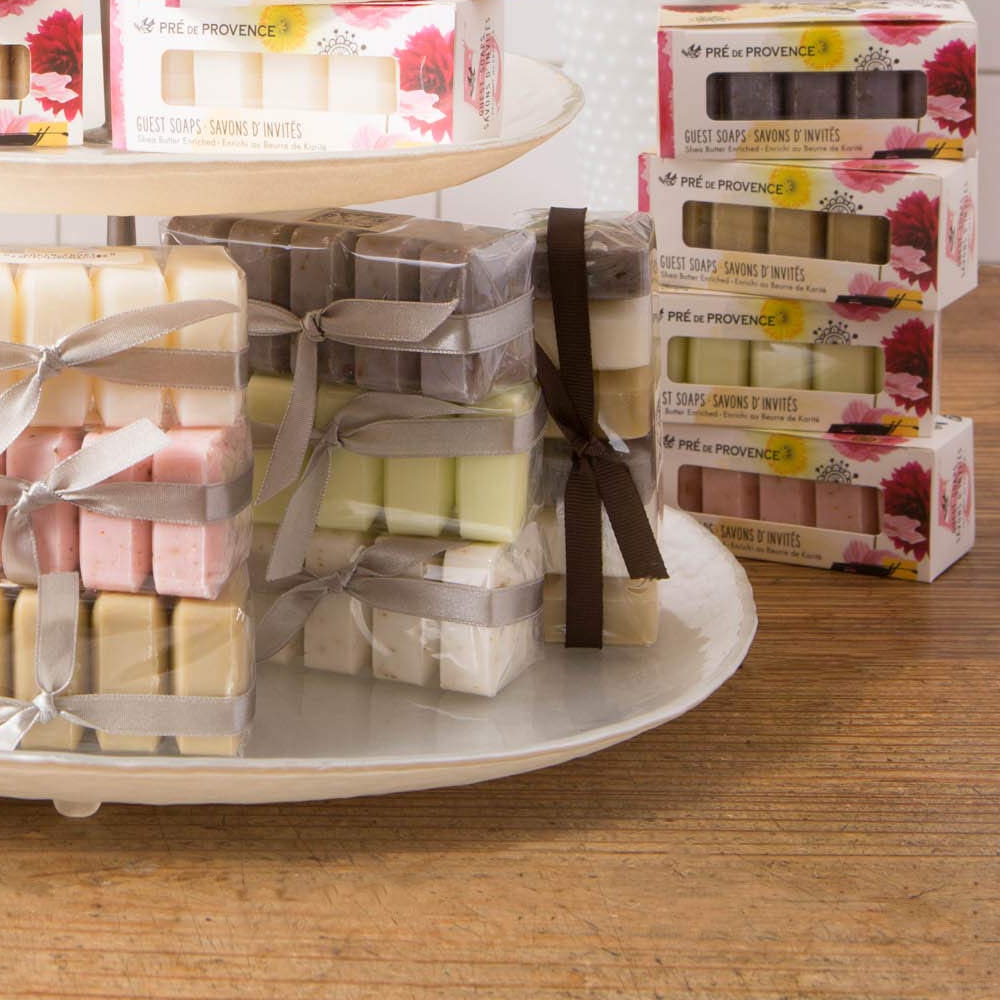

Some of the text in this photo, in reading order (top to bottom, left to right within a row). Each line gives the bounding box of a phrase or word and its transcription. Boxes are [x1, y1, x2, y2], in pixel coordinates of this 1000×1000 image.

[160, 19, 275, 37] PRÉ DE PROVENCE
[706, 44, 729, 57] PRÉ
[746, 46, 815, 57] PROVENCE
[137, 116, 165, 133] GUEST
[170, 118, 200, 135] SOAPS
[210, 120, 248, 136] SAVONS
[685, 129, 712, 143] GUEST
[717, 129, 746, 143] SOAPS
[754, 129, 790, 143] SAVONS
[681, 175, 783, 195] PRÉ DE PROVENCE
[660, 255, 685, 271] GUEST
[690, 258, 717, 273] SOAPS
[725, 262, 757, 278] SAVONS
[668, 309, 775, 326] PRÉ DE PROVENCE
[676, 393, 705, 407] SOAPS
[713, 394, 748, 409] SAVONS
[678, 438, 780, 460] PRÉ DE PROVENCE
[721, 525, 754, 542] SAVONS
